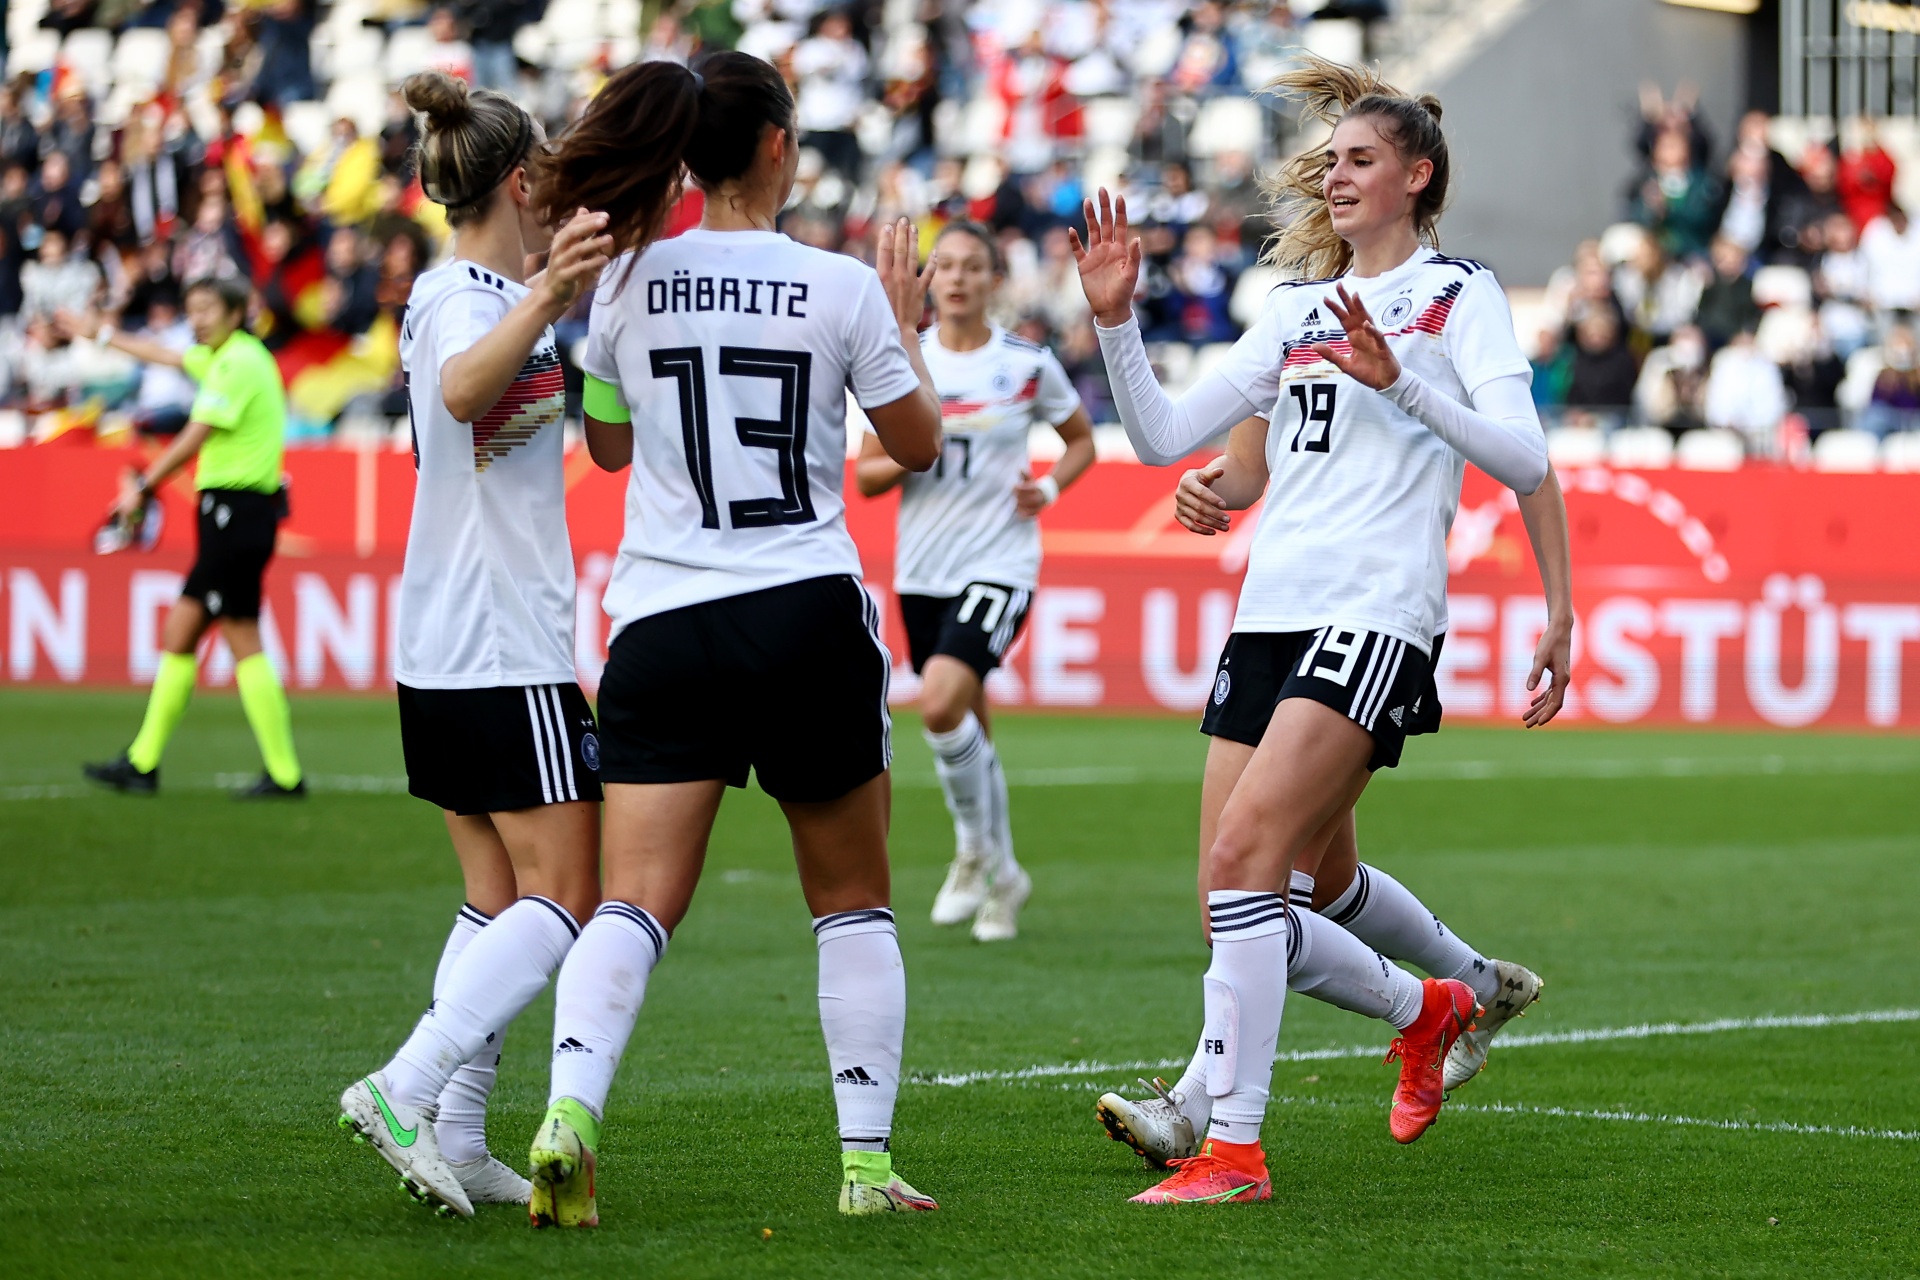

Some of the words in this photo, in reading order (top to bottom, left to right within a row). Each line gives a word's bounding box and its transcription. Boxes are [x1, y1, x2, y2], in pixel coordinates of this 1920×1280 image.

[648, 270, 809, 319] DÄBRITZ
[1301, 320, 1321, 328] adidas
[649, 346, 818, 530] 13
[1289, 383, 1338, 454] 19
[0, 567, 88, 684] N
[1296, 625, 1369, 687] 19
[834, 1077, 879, 1087] adidas
